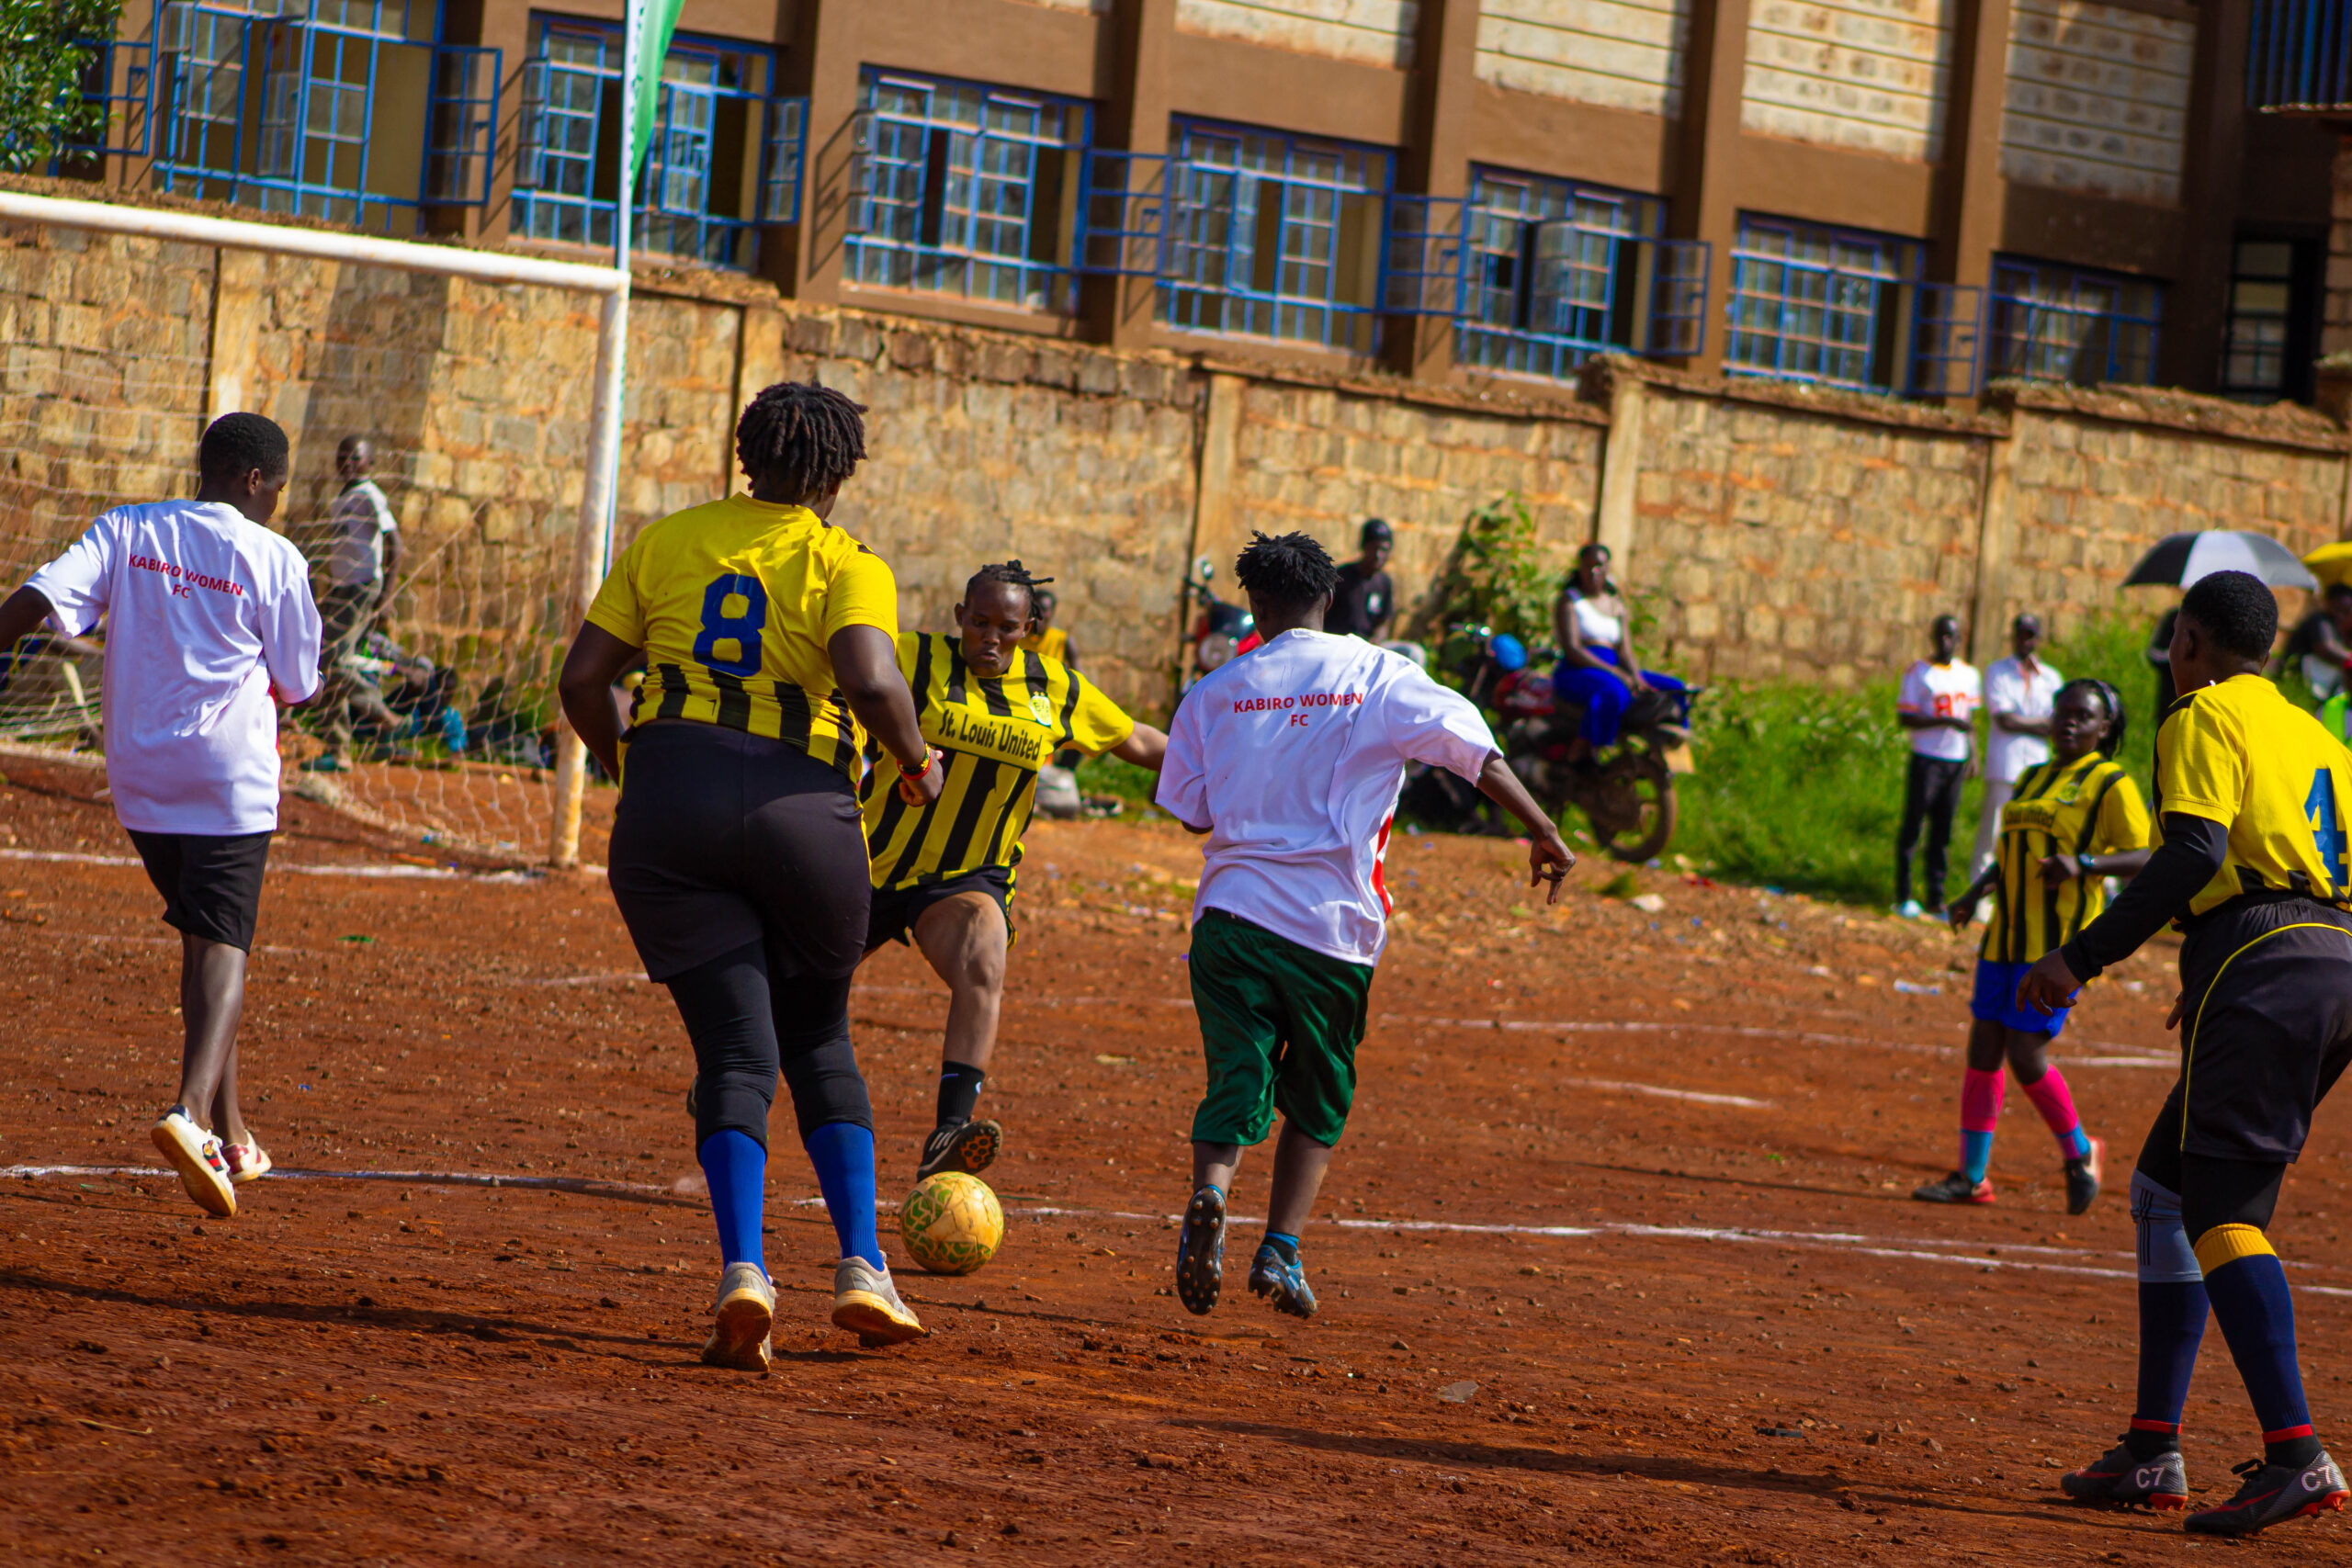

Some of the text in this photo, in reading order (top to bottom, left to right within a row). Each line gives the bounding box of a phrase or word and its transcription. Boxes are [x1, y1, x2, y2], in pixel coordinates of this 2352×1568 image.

[129, 553, 243, 596] KABIRO WOMEN
[172, 584, 191, 599] FC
[693, 572, 768, 678] 8
[1234, 693, 1363, 713] KABIRO WOMEN
[1290, 714, 1308, 728] FC
[938, 708, 1043, 762] St. Louis United
[2303, 767, 2349, 886] 4
[2134, 1467, 2165, 1489] C7
[2301, 1465, 2331, 1492] C7
